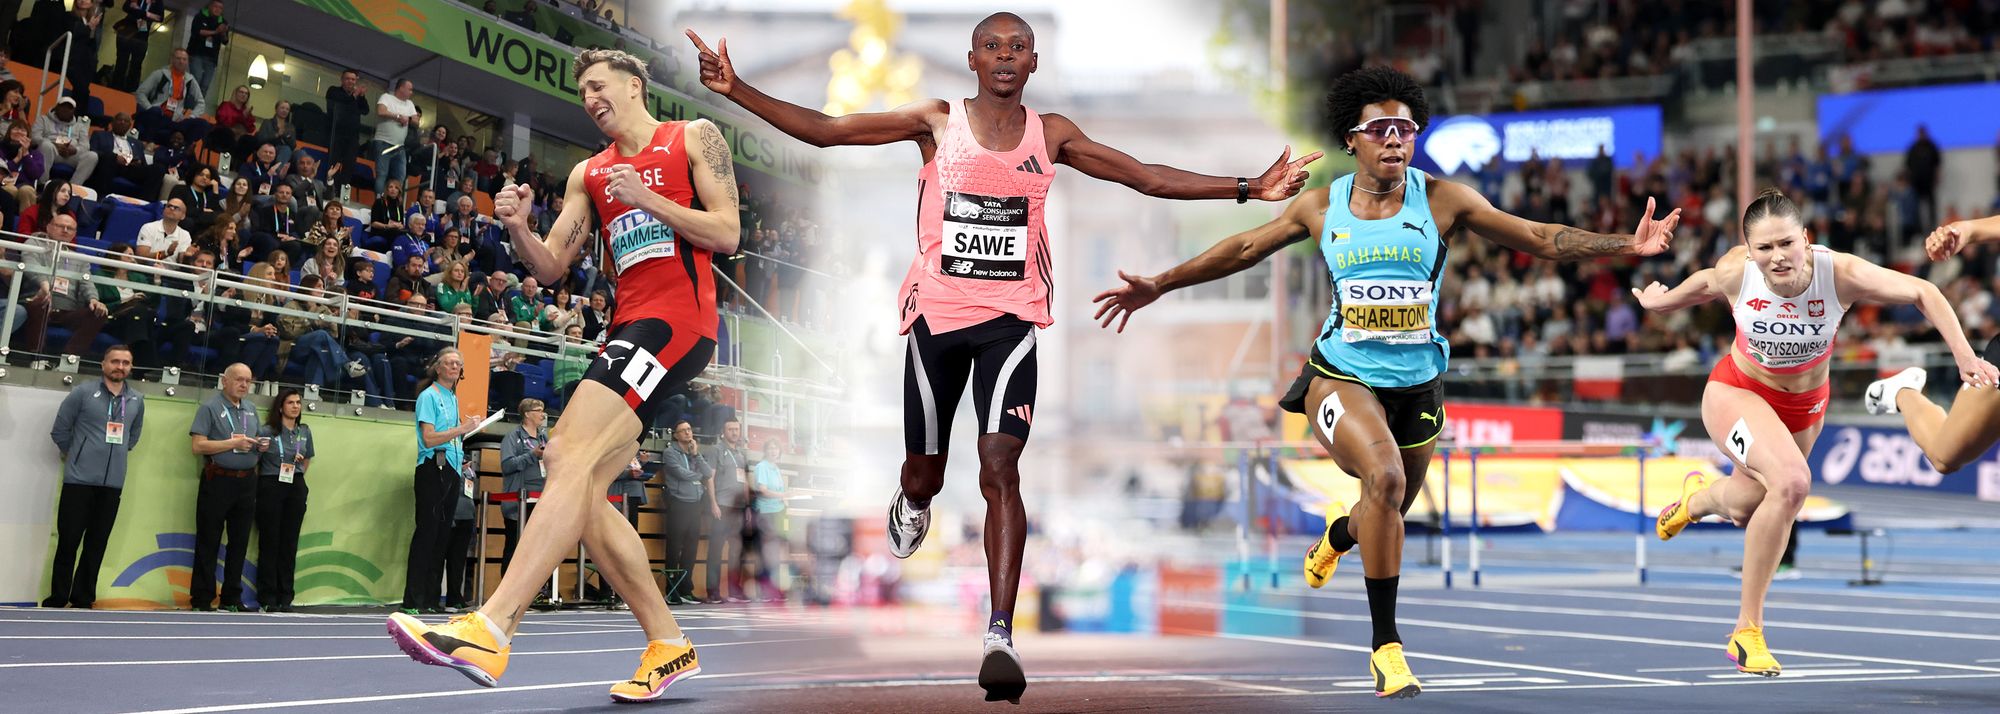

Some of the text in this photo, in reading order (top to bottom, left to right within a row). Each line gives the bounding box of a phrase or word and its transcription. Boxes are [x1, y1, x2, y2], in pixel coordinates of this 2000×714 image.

[465, 20, 578, 96] WORL
[954, 232, 1016, 256] SAWE
[1336, 245, 1422, 269] BAHAMAS
[989, 269, 1017, 277] balance
[1349, 285, 1424, 300] SONY
[1345, 307, 1426, 328] CHARLTON
[1752, 321, 1825, 336] SONY
[645, 361, 655, 387] 1
[1323, 403, 1335, 429] 6
[1731, 430, 1745, 455] 5
[654, 648, 696, 680] NITRO
